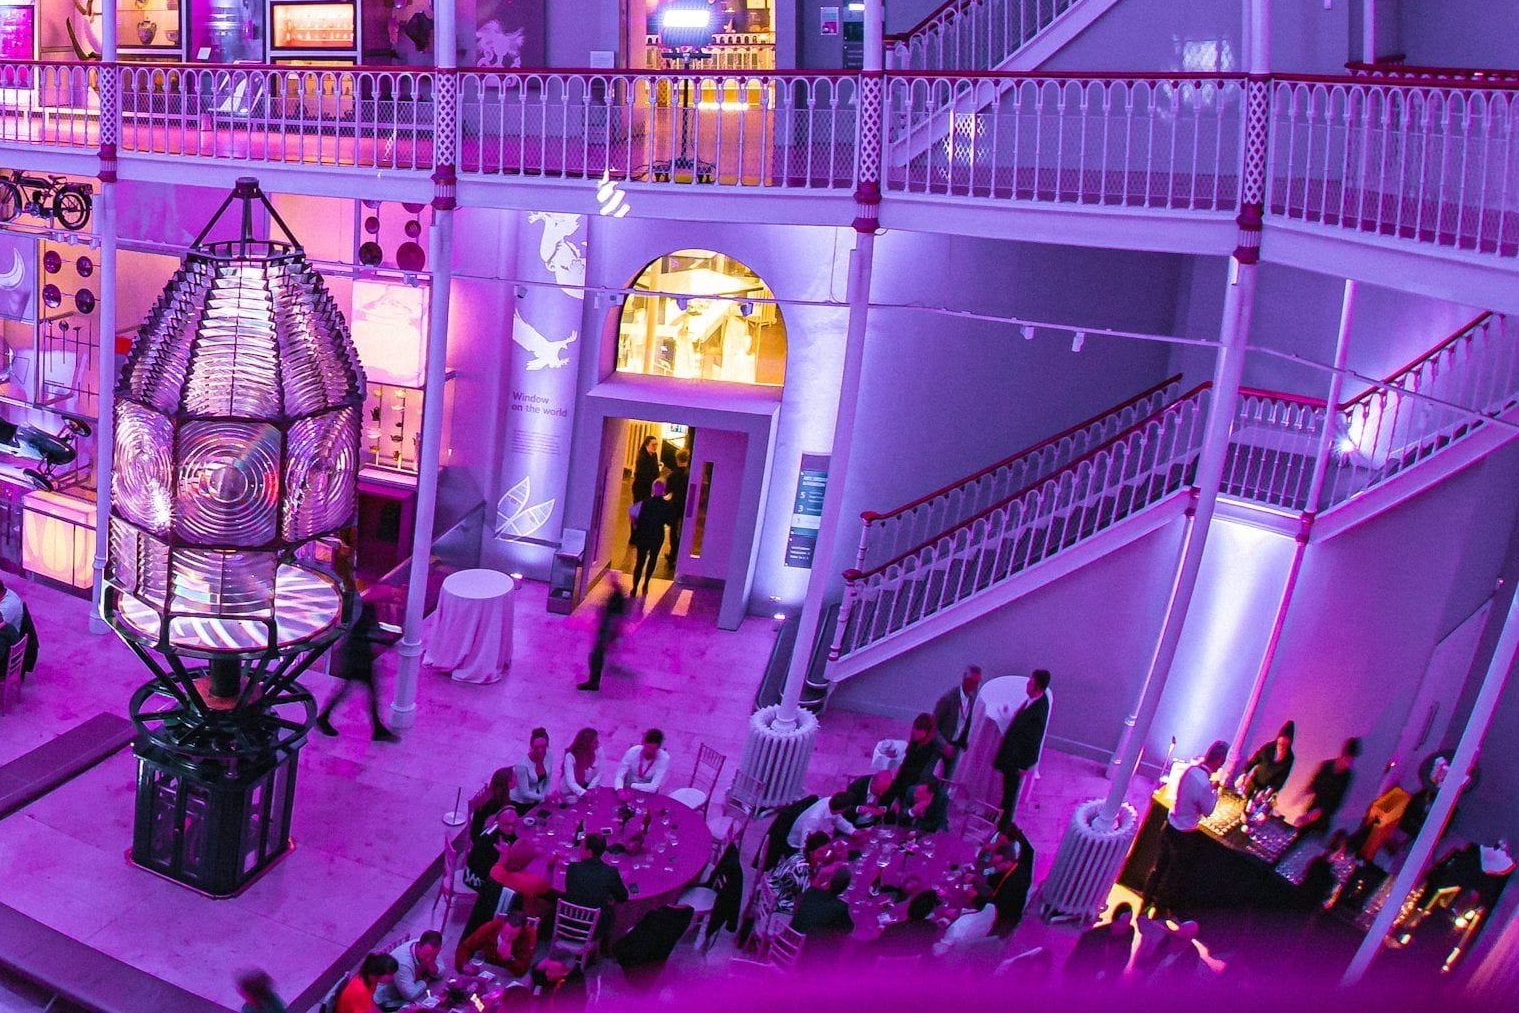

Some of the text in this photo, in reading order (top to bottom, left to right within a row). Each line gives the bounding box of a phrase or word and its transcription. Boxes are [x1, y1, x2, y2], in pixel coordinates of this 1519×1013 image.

[512, 391, 550, 404] Window
[511, 404, 568, 418] on the world
[800, 491, 806, 499] 5
[797, 504, 804, 512] 3
